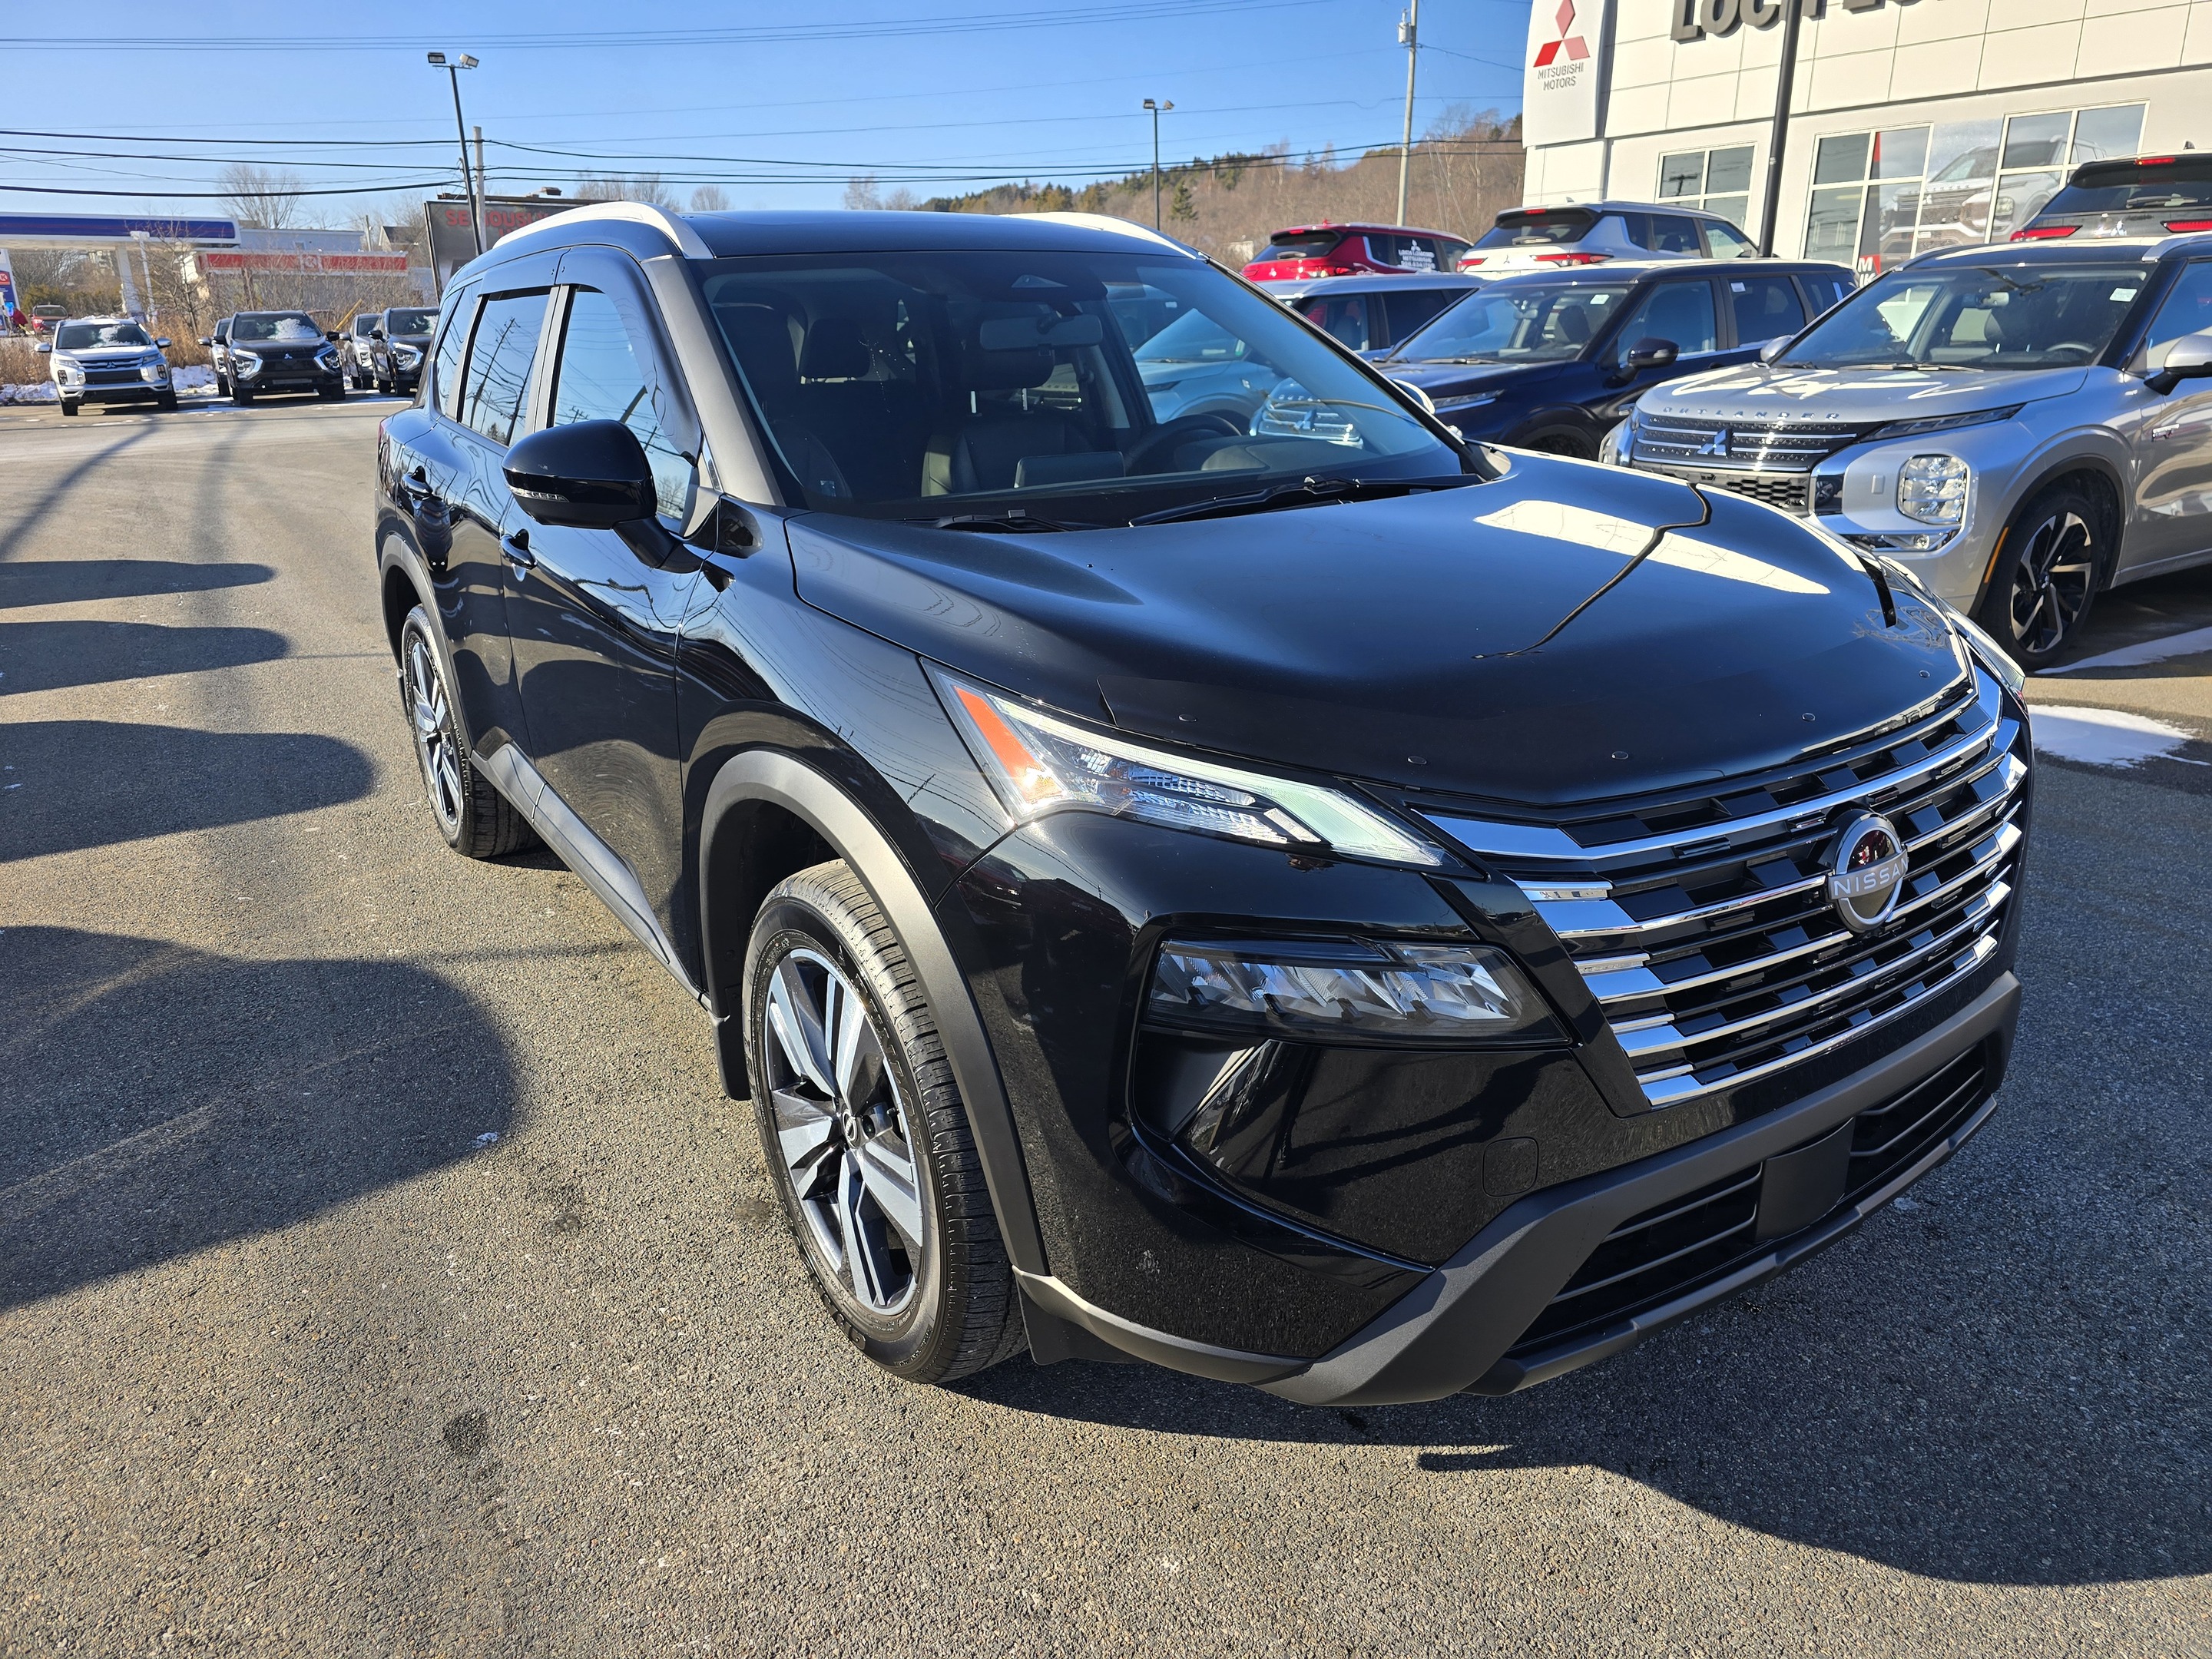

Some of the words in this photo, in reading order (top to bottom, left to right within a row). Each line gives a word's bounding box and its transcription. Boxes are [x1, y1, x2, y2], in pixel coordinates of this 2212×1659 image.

[1538, 62, 1584, 80] MITSUBISHI
[1543, 75, 1576, 91] MOTORS
[1663, 406, 1839, 420] OUTLANDER
[1833, 858, 1909, 896] NISSAN
